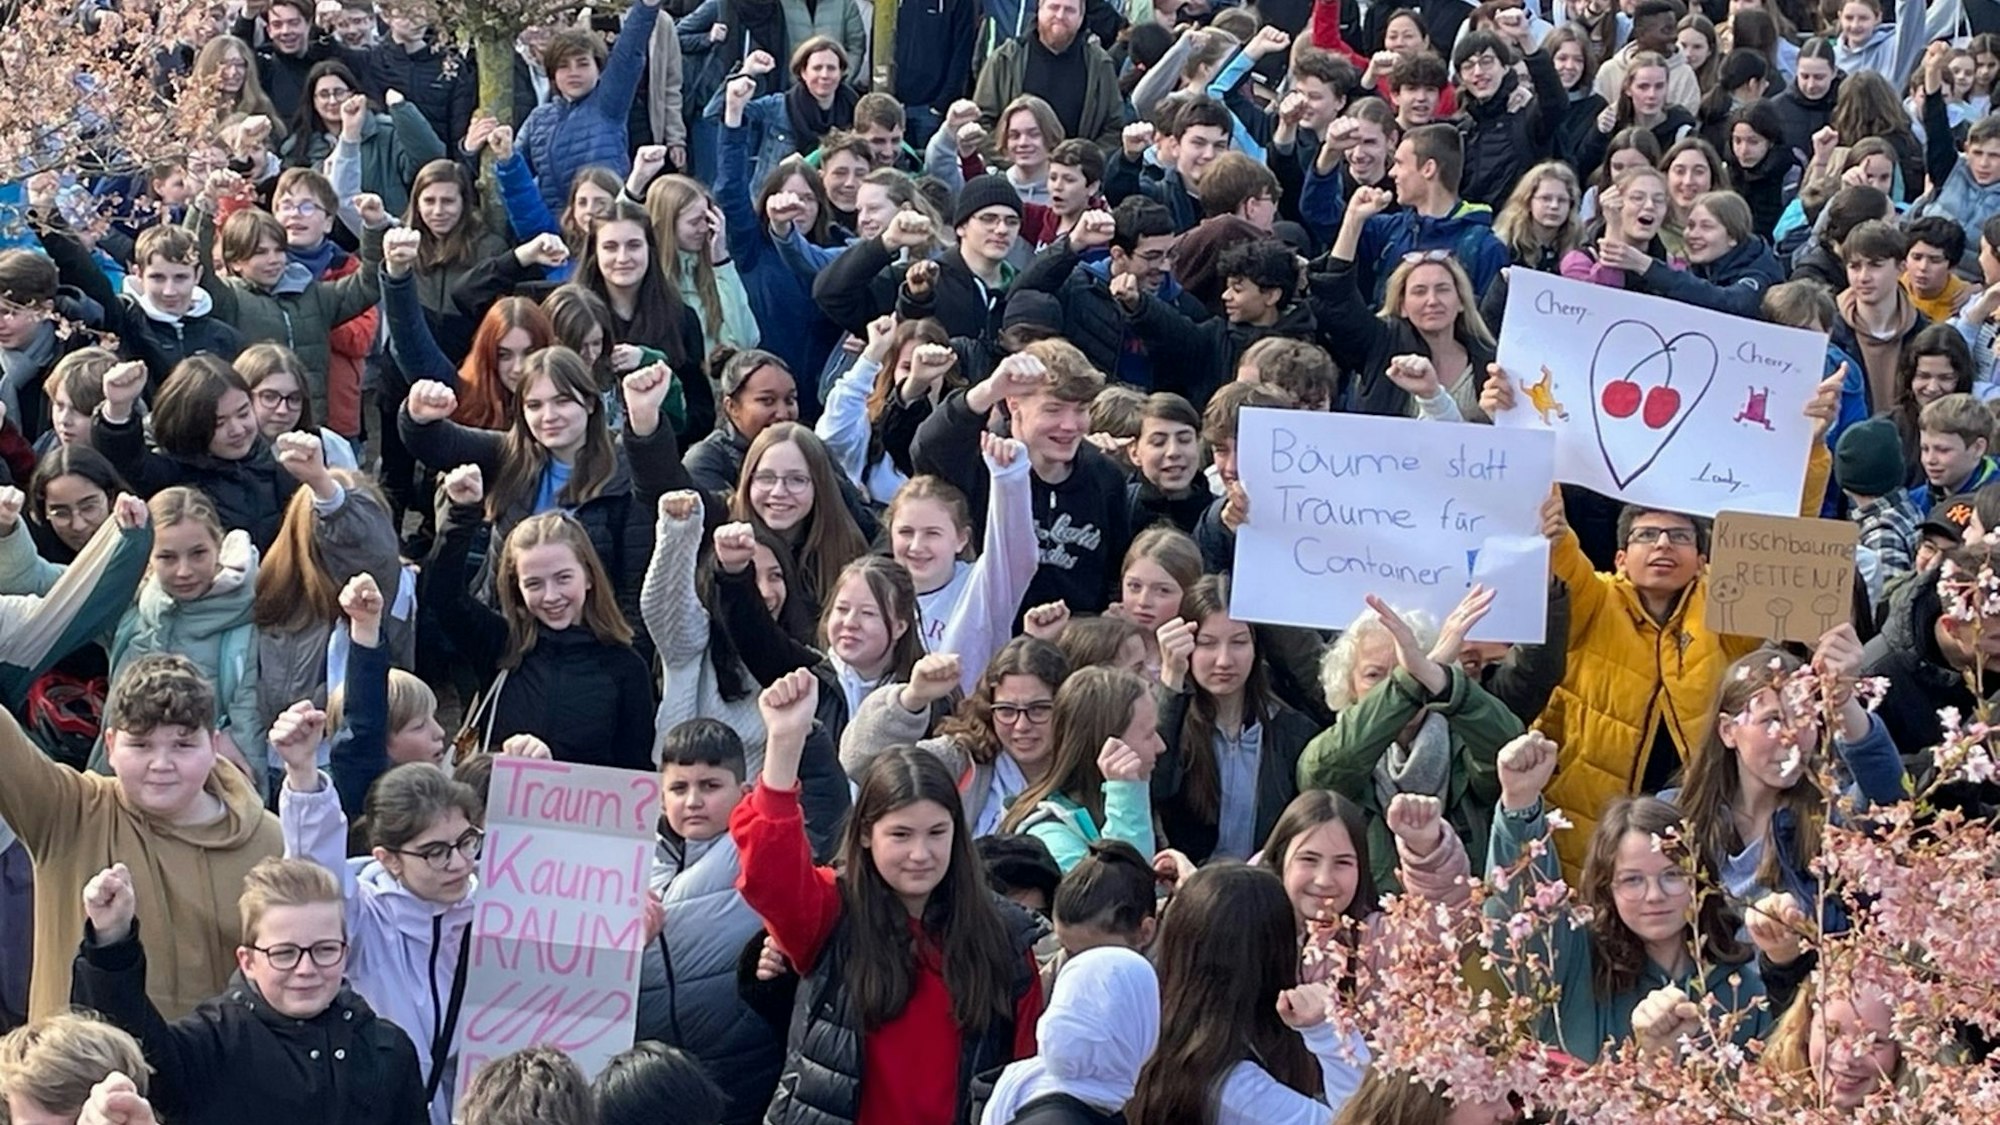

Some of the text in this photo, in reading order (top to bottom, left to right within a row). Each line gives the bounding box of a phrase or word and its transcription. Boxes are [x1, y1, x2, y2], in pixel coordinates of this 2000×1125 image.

[1271, 427, 1509, 481] Bäume statt
[1440, 496, 1487, 533] für
[495, 759, 659, 831] Traum?
[485, 830, 645, 908] Kaum!
[473, 902, 643, 982] RAUM
[466, 981, 632, 1051] UND
